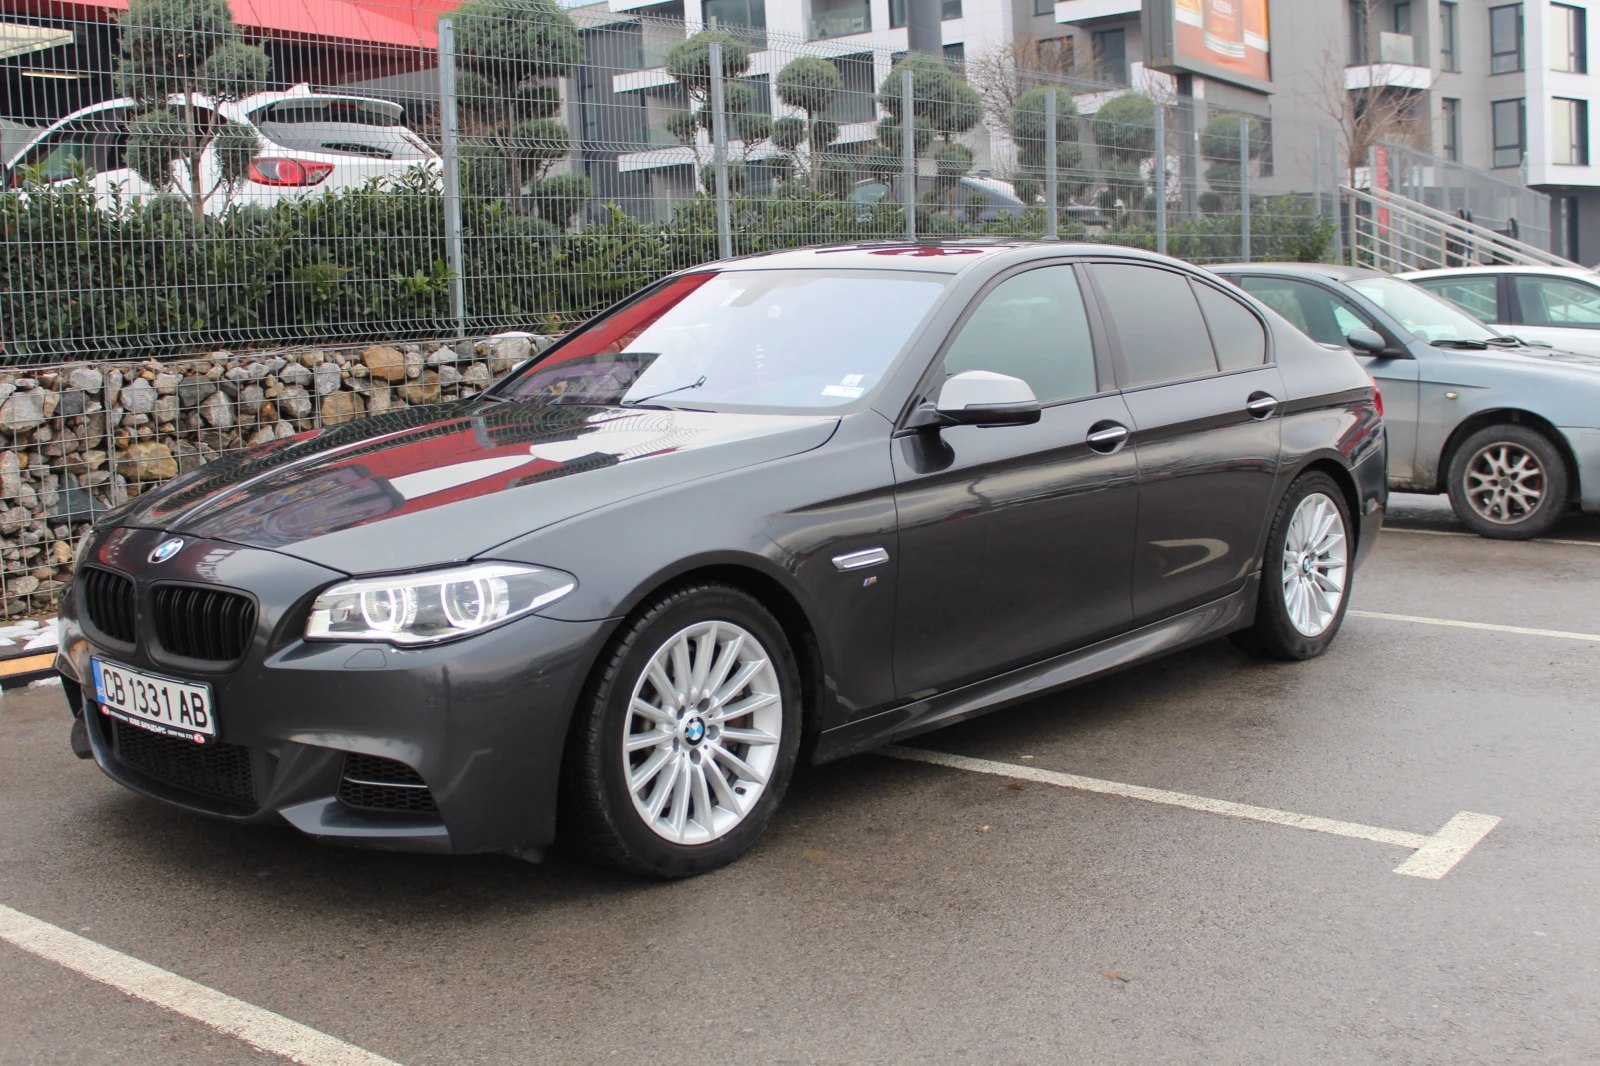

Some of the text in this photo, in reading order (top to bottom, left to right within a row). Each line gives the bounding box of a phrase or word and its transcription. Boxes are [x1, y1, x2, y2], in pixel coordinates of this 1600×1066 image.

[103, 669, 208, 728] CB 1331 AB
